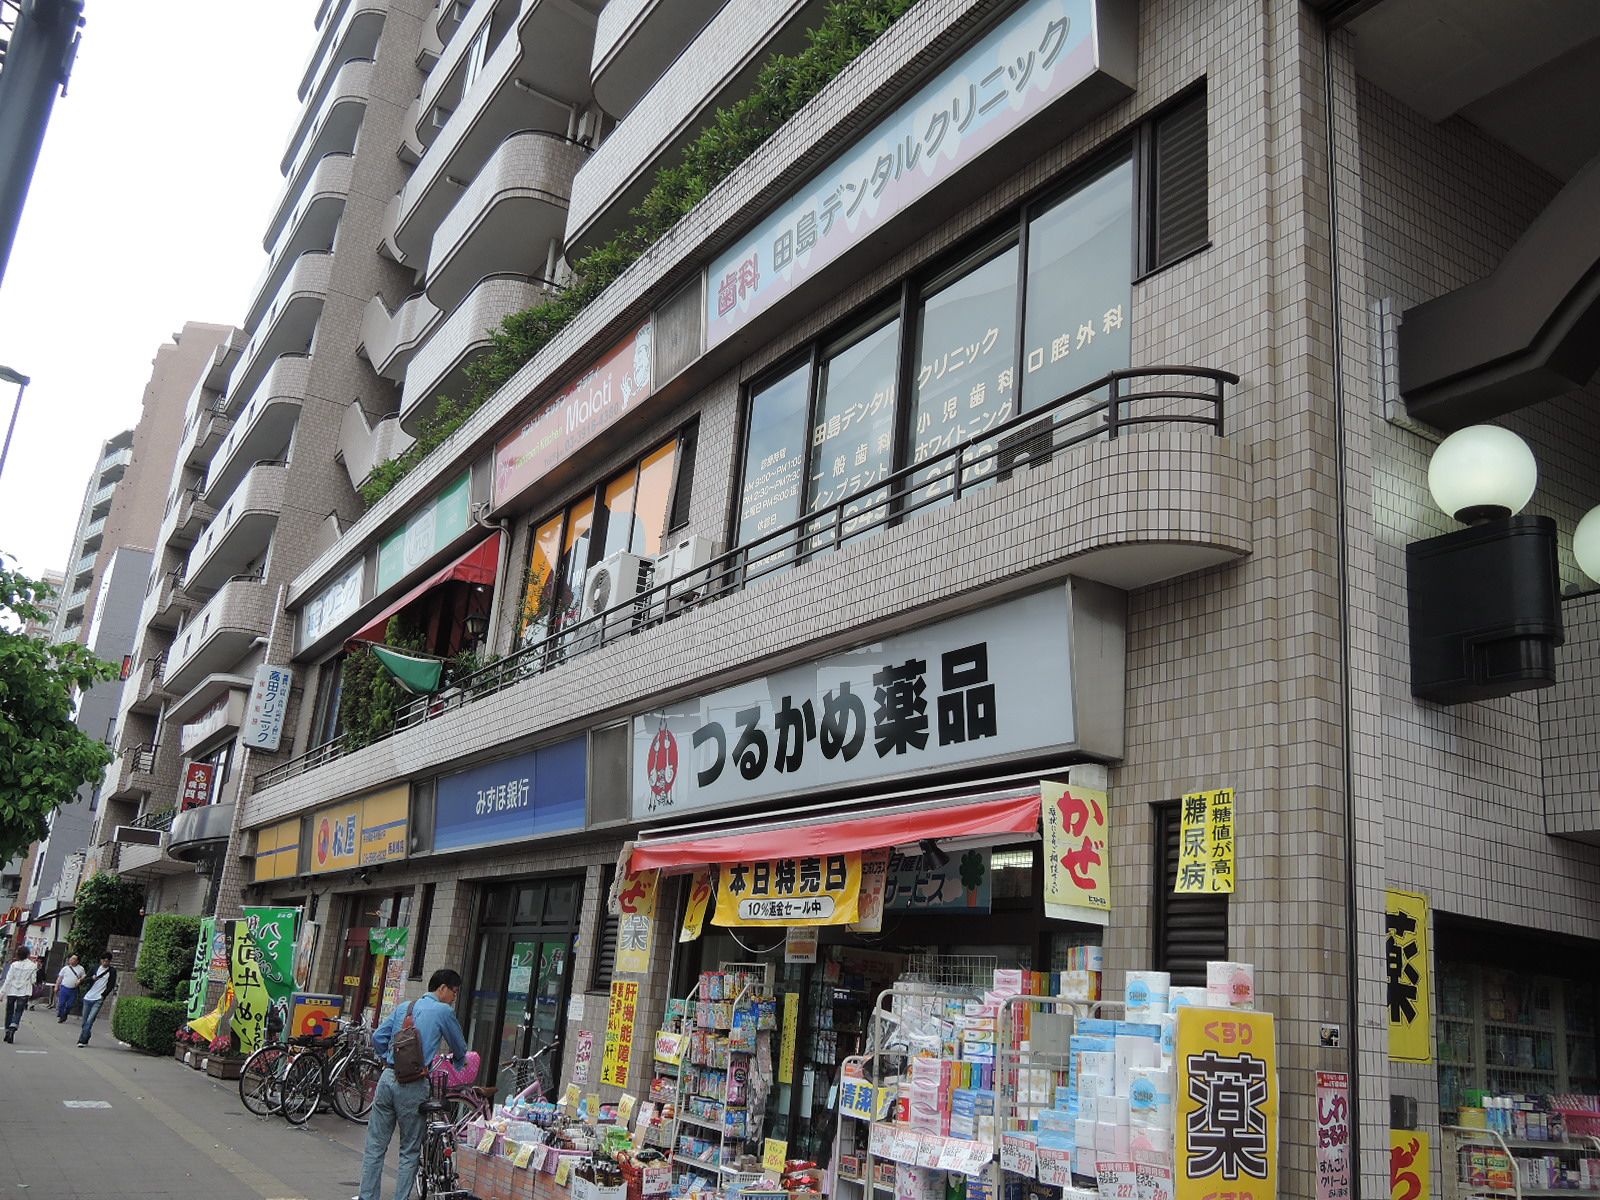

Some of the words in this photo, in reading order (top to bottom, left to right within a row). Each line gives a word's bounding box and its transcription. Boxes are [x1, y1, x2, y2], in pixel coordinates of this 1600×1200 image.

[717, 252, 760, 317] 歯科
[772, 15, 1071, 272] 田島デンタルクリニック
[917, 327, 1000, 391] クリニック
[1027, 304, 1124, 374] 口腔外科
[565, 372, 613, 435] Malati
[692, 641, 997, 789] つるかめ薬品
[475, 778, 529, 815] みずほ銀行
[332, 814, 356, 858] 松屋
[1056, 790, 1104, 890] かぜ
[1180, 795, 1207, 890] 糖尿病
[1211, 790, 1233, 892] 血糖値が高い
[728, 854, 847, 896] 本日特売日
[747, 898, 822, 918] 10%返金セール中
[615, 982, 638, 1085] 肝機能障害
[1204, 1021, 1254, 1046] くすり
[1187, 1050, 1268, 1180] 薬
[1318, 1095, 1348, 1126] しわ
[1318, 1123, 1348, 1149] たるみ
[1320, 1174, 1348, 1188] クリーム
